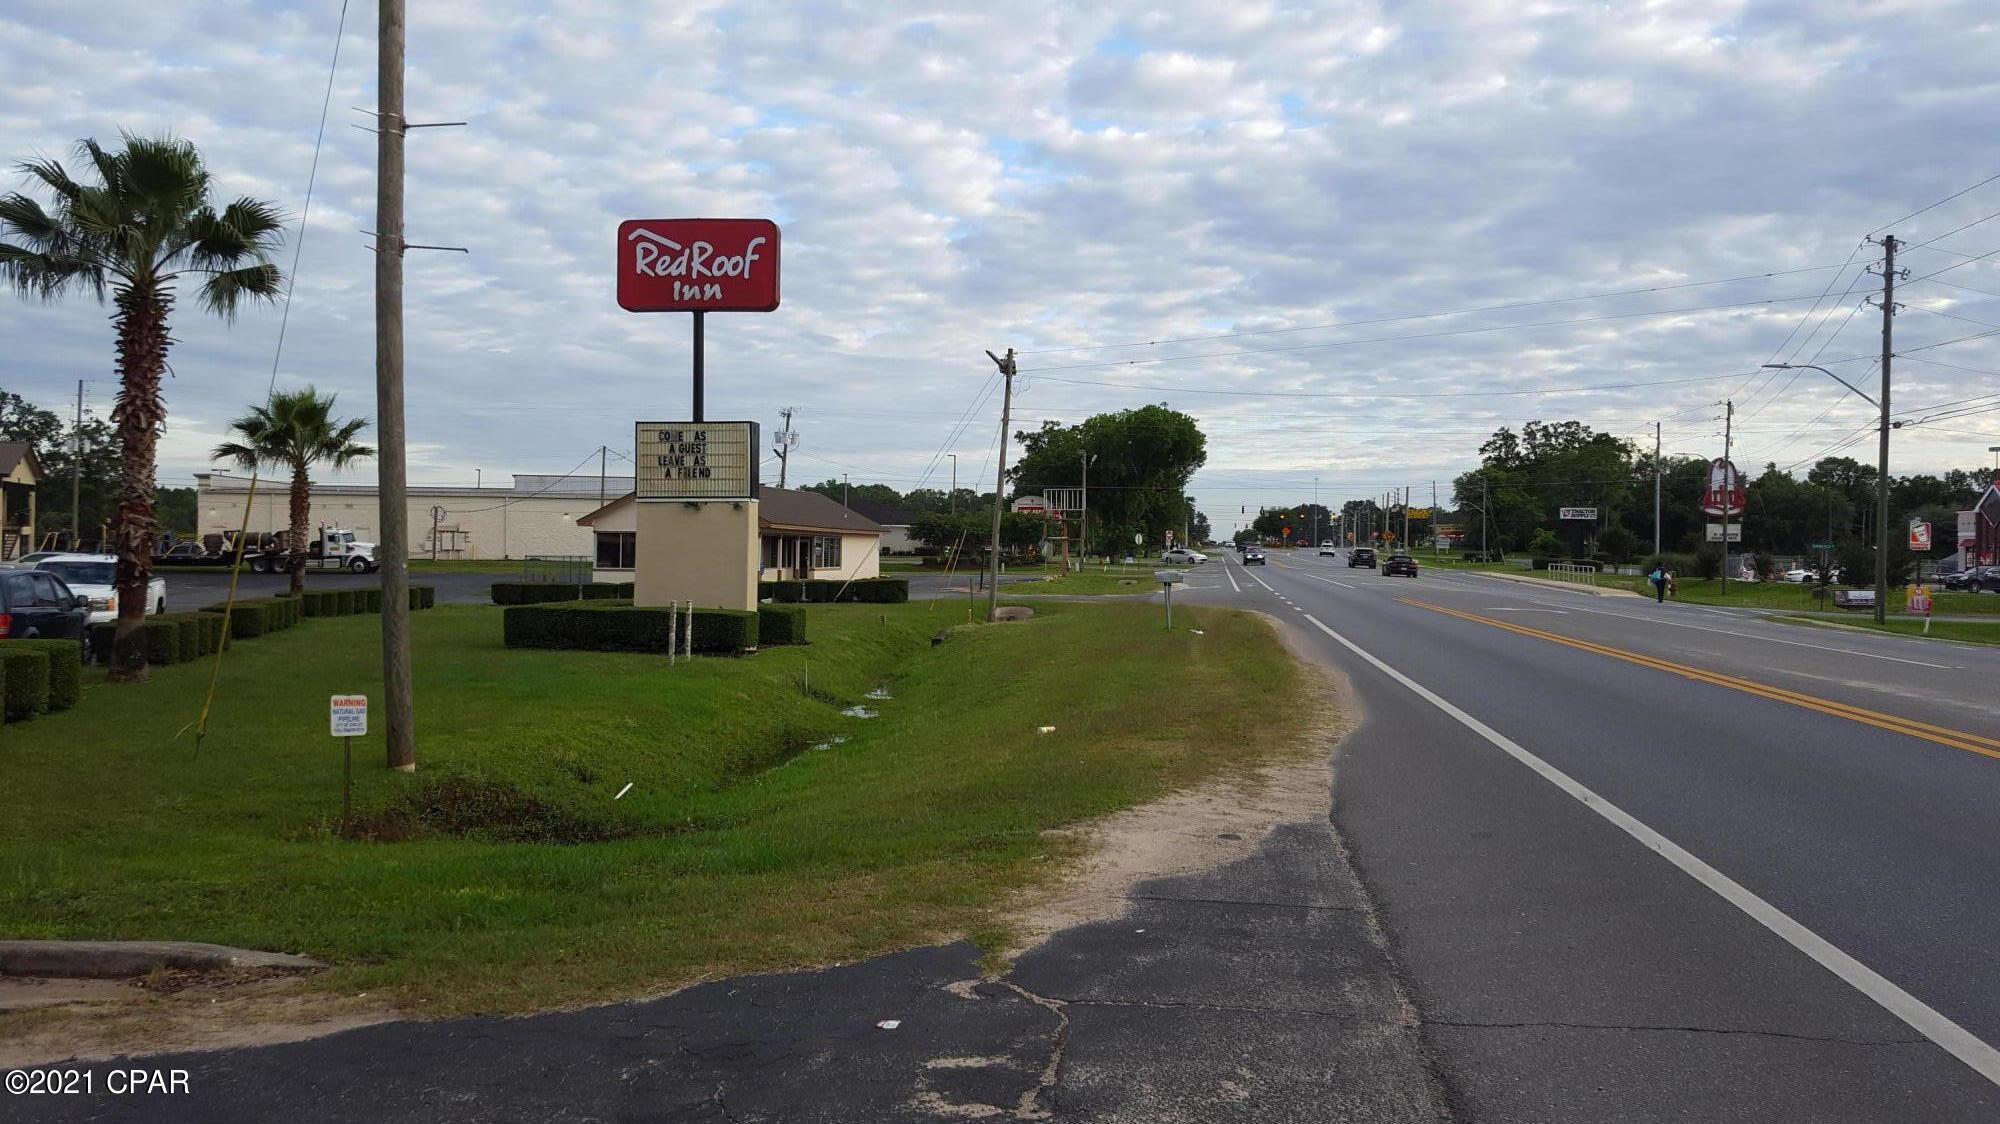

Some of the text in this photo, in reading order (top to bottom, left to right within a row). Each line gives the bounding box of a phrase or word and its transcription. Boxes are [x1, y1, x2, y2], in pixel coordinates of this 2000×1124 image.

[636, 236, 766, 279] Red Roof
[673, 280, 722, 301] Inn
[659, 431, 707, 441] COE AS
[669, 443, 707, 454] A GUEST
[658, 455, 706, 466] LEAVE AS
[665, 467, 711, 478] A FIEND
[332, 698, 366, 707] WARNING
